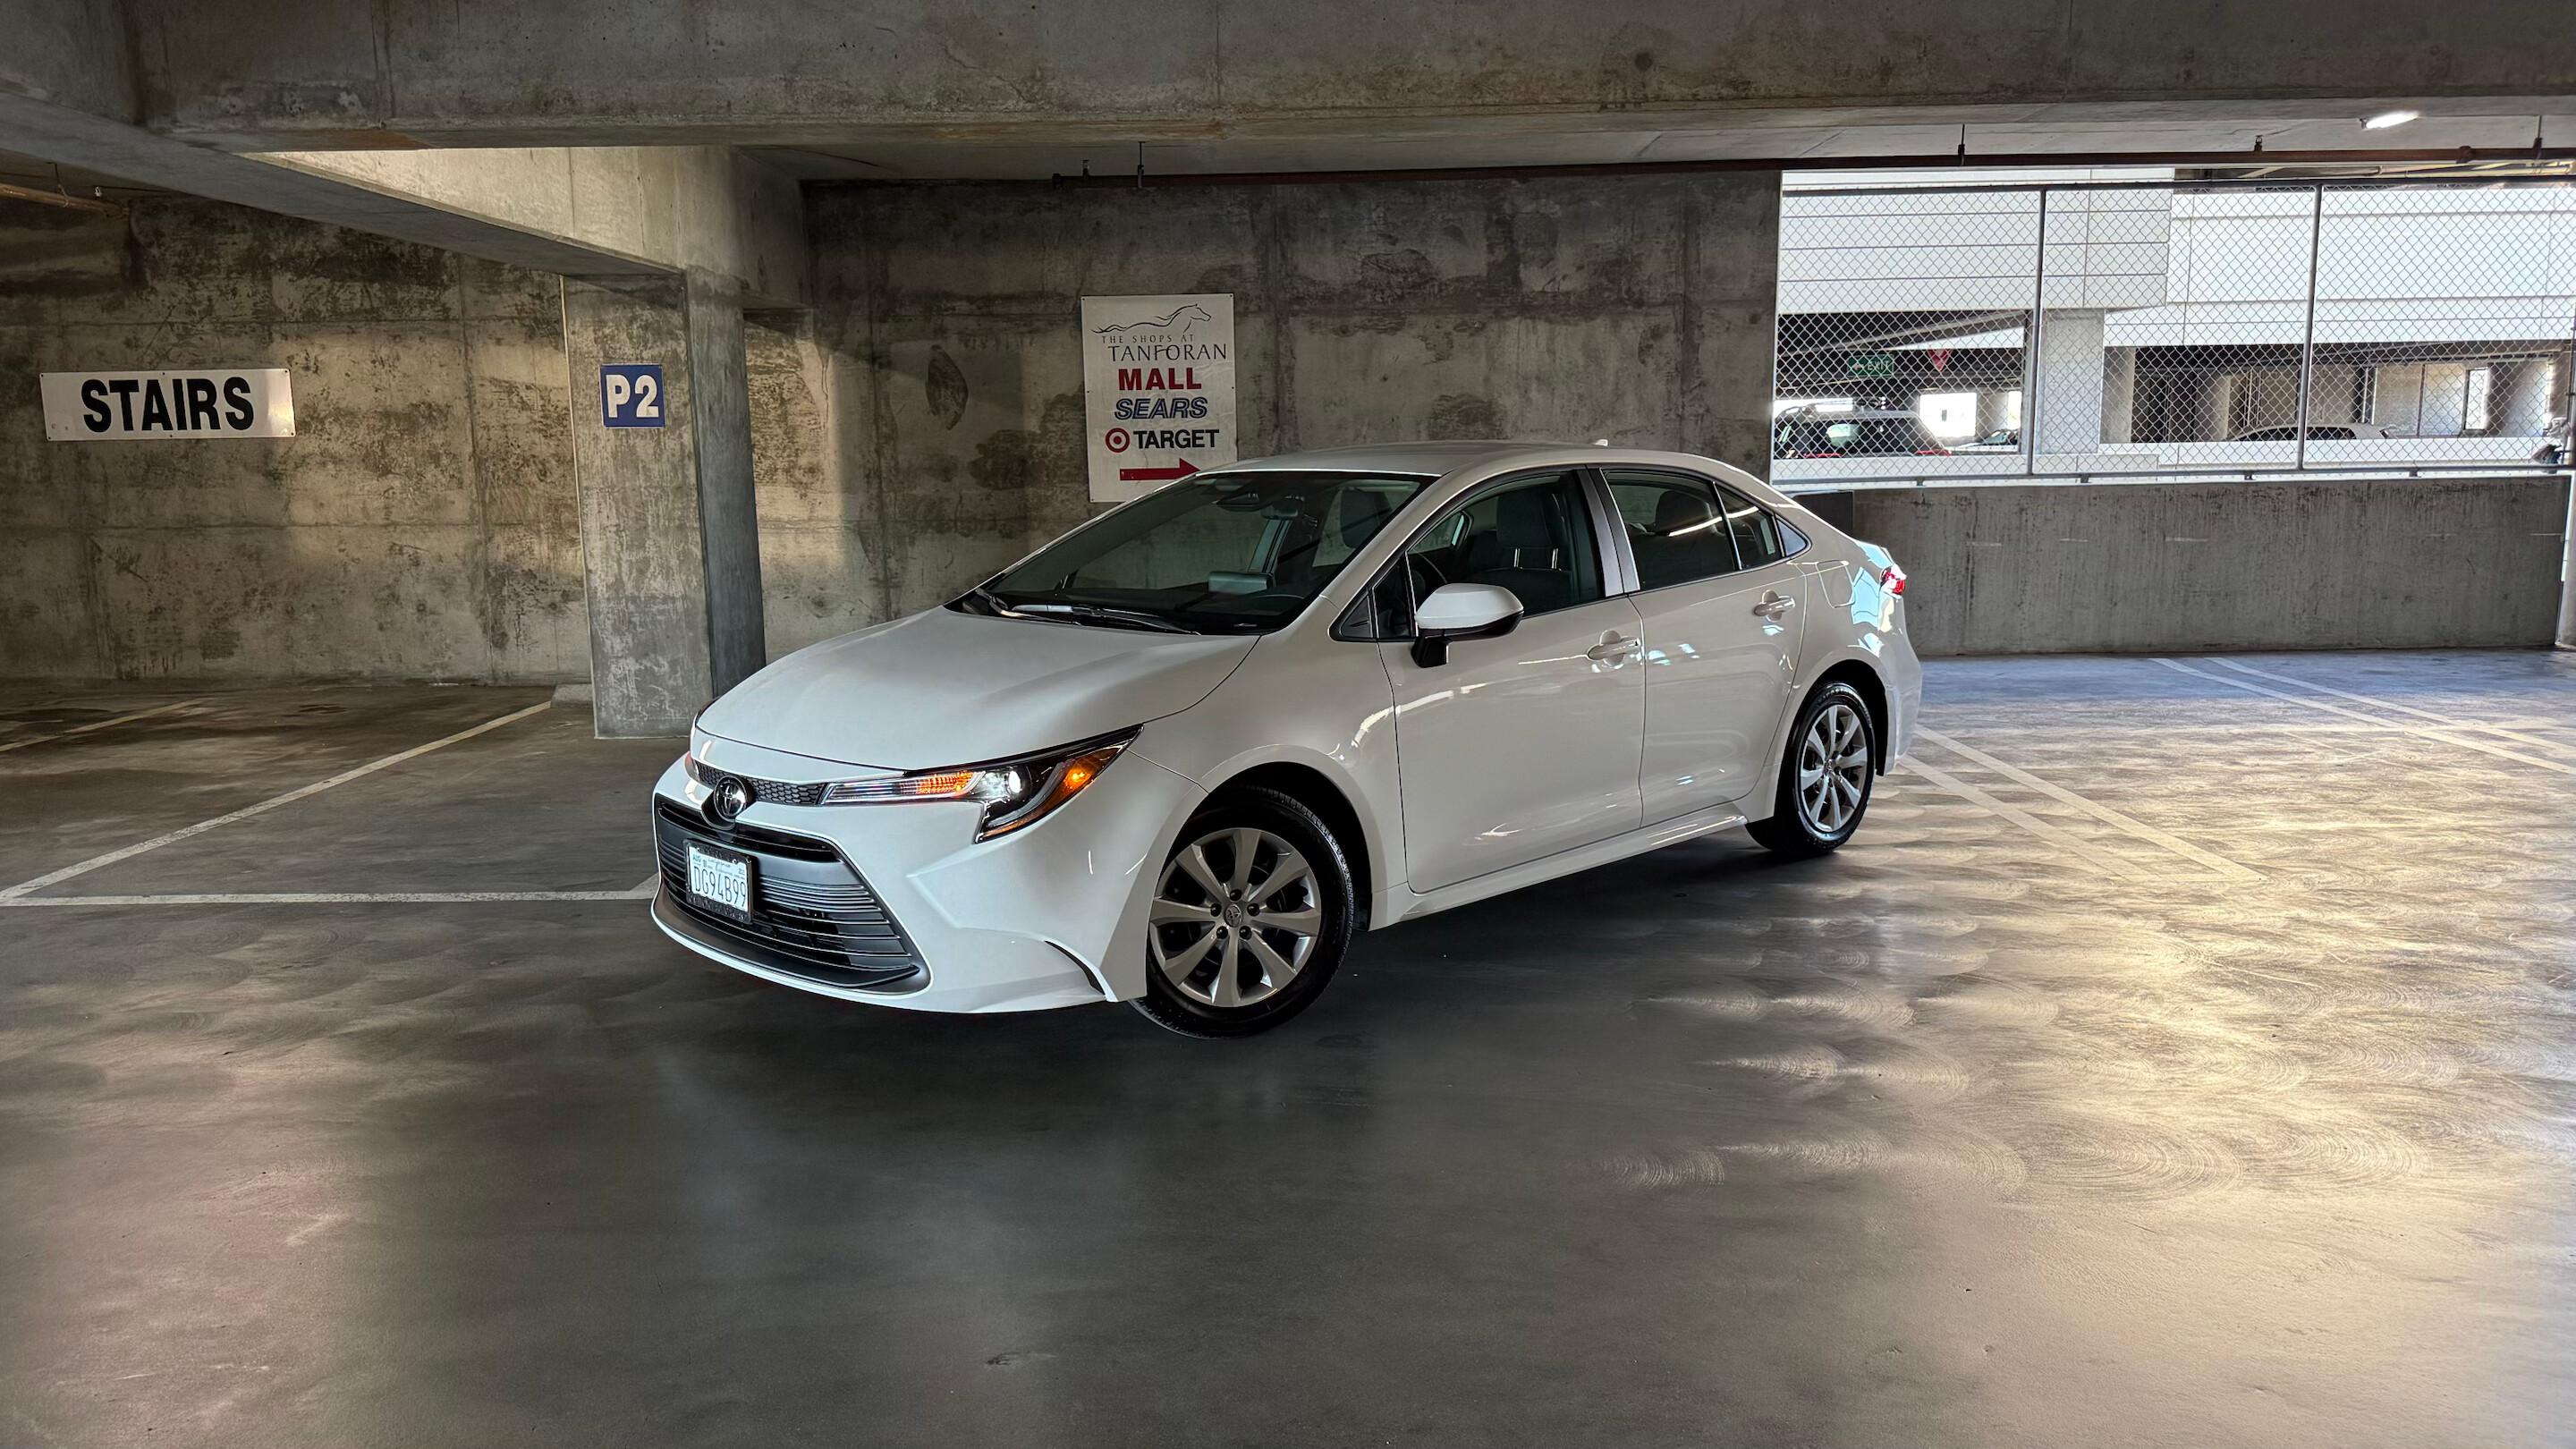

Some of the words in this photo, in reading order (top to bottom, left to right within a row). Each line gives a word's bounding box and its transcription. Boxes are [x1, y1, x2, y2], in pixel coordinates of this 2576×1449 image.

[1102, 335, 1124, 344] THE
[1132, 335, 1173, 343] SHOPS
[1181, 334, 1194, 343] AT
[1107, 343, 1227, 362] TANFORAN
[1867, 360, 1890, 370] EXIT
[1118, 367, 1202, 391] MALL
[80, 376, 255, 433] STAIRS
[606, 374, 659, 419] P2
[1114, 396, 1208, 420] SEARS
[1133, 428, 1220, 449] TARGET
[693, 865, 747, 908] DG94B99
